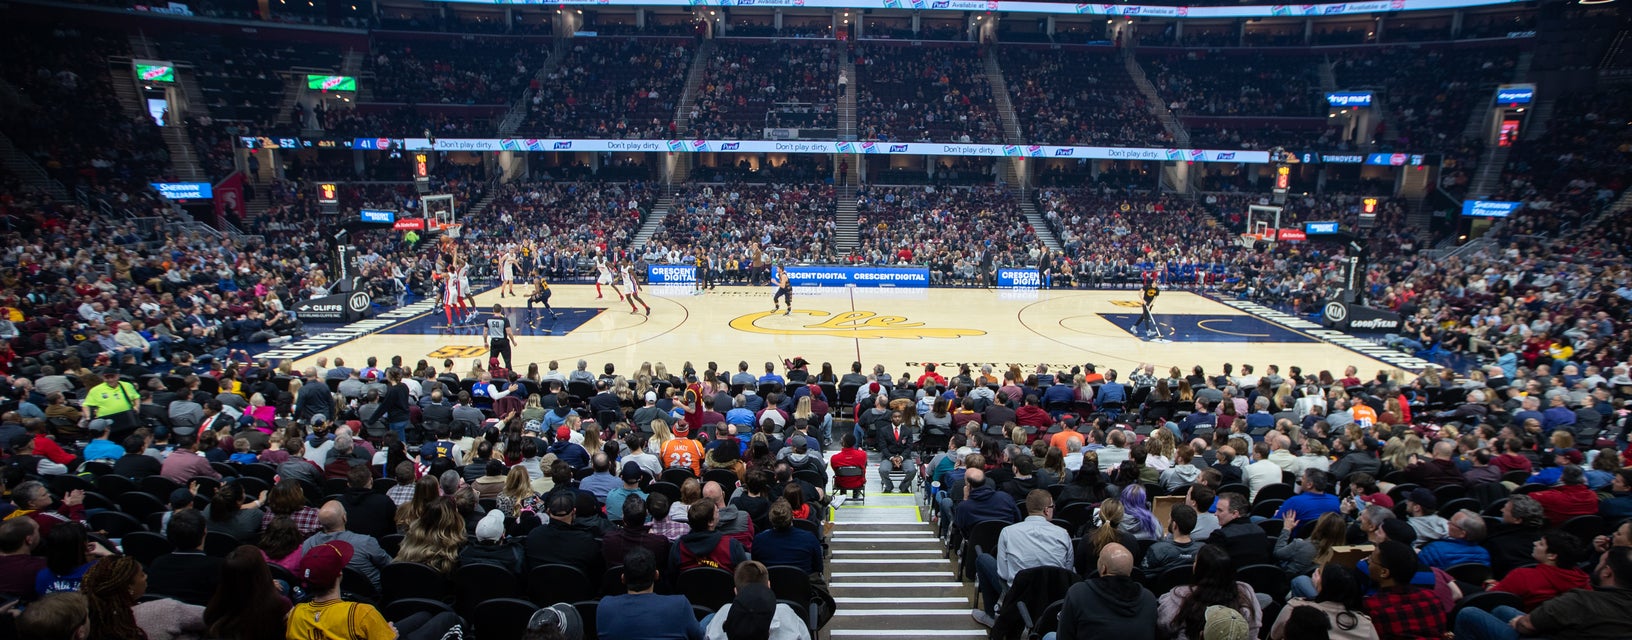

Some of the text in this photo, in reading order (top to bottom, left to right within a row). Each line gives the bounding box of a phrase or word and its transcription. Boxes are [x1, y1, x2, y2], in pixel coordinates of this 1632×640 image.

[279, 138, 295, 148] 52
[360, 140, 371, 148] 41
[460, 141, 474, 149] play
[476, 141, 493, 149] dirty.
[626, 142, 641, 150] play
[642, 142, 659, 150] dirty.
[795, 143, 809, 151] play
[811, 143, 828, 151] dirty.
[962, 146, 977, 154] play
[979, 146, 995, 154] dirty.
[1126, 149, 1141, 158] play
[1142, 150, 1158, 158] dirty.
[1322, 155, 1363, 163] TURNOVERS
[1373, 154, 1382, 163] 4
[160, 183, 200, 191] SHERWIN
[1474, 200, 1512, 209] SHERWIN
[354, 296, 367, 309] KIA
[312, 304, 343, 312] CLIFFS
[1328, 305, 1342, 318] KIA
[1351, 318, 1399, 329] GOODYEAR
[670, 452, 692, 467] 23
